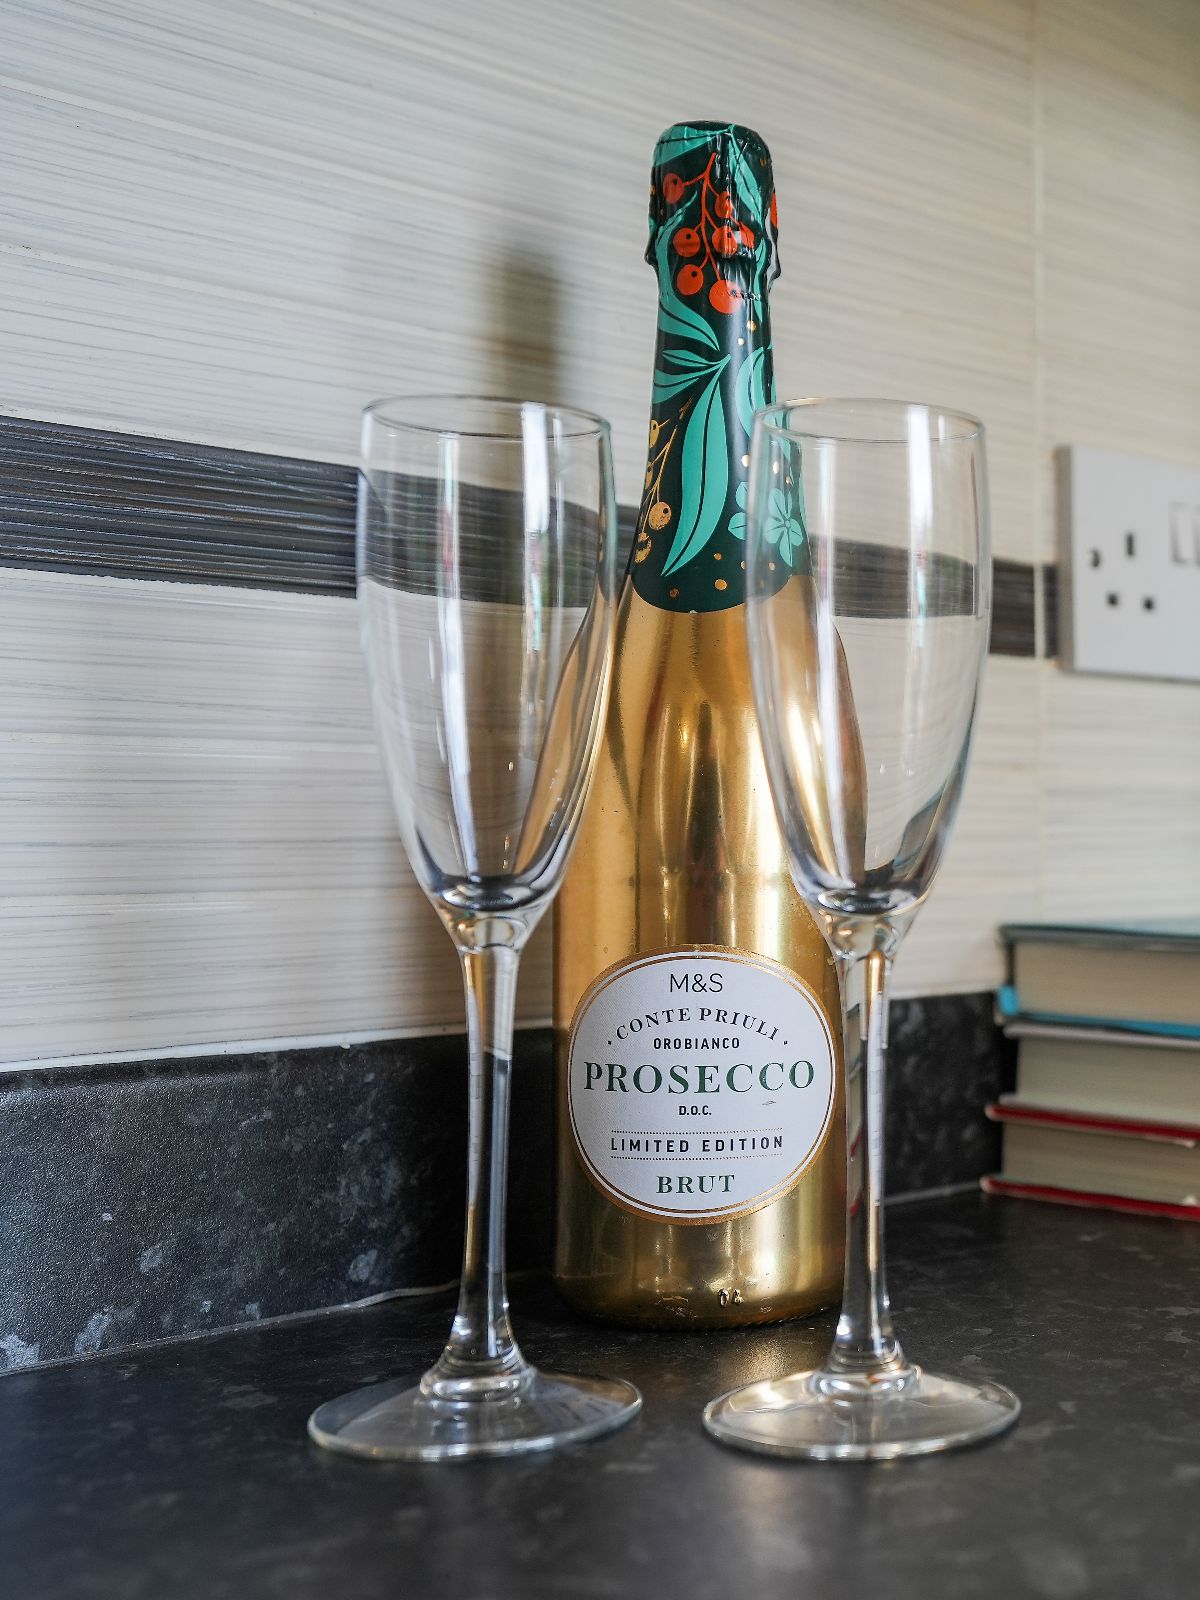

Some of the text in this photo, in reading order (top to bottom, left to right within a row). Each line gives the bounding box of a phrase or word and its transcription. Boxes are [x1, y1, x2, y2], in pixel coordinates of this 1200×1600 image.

[669, 973, 723, 993] M&S
[616, 1007, 779, 1041] CONTE PRIULI
[653, 1037, 740, 1050] OROBIANCO
[583, 1060, 815, 1095] PROSECCO
[678, 1105, 712, 1116] D.O.C.
[611, 1135, 784, 1153] LIMITED EDITION
[656, 1174, 735, 1194] BRUT
